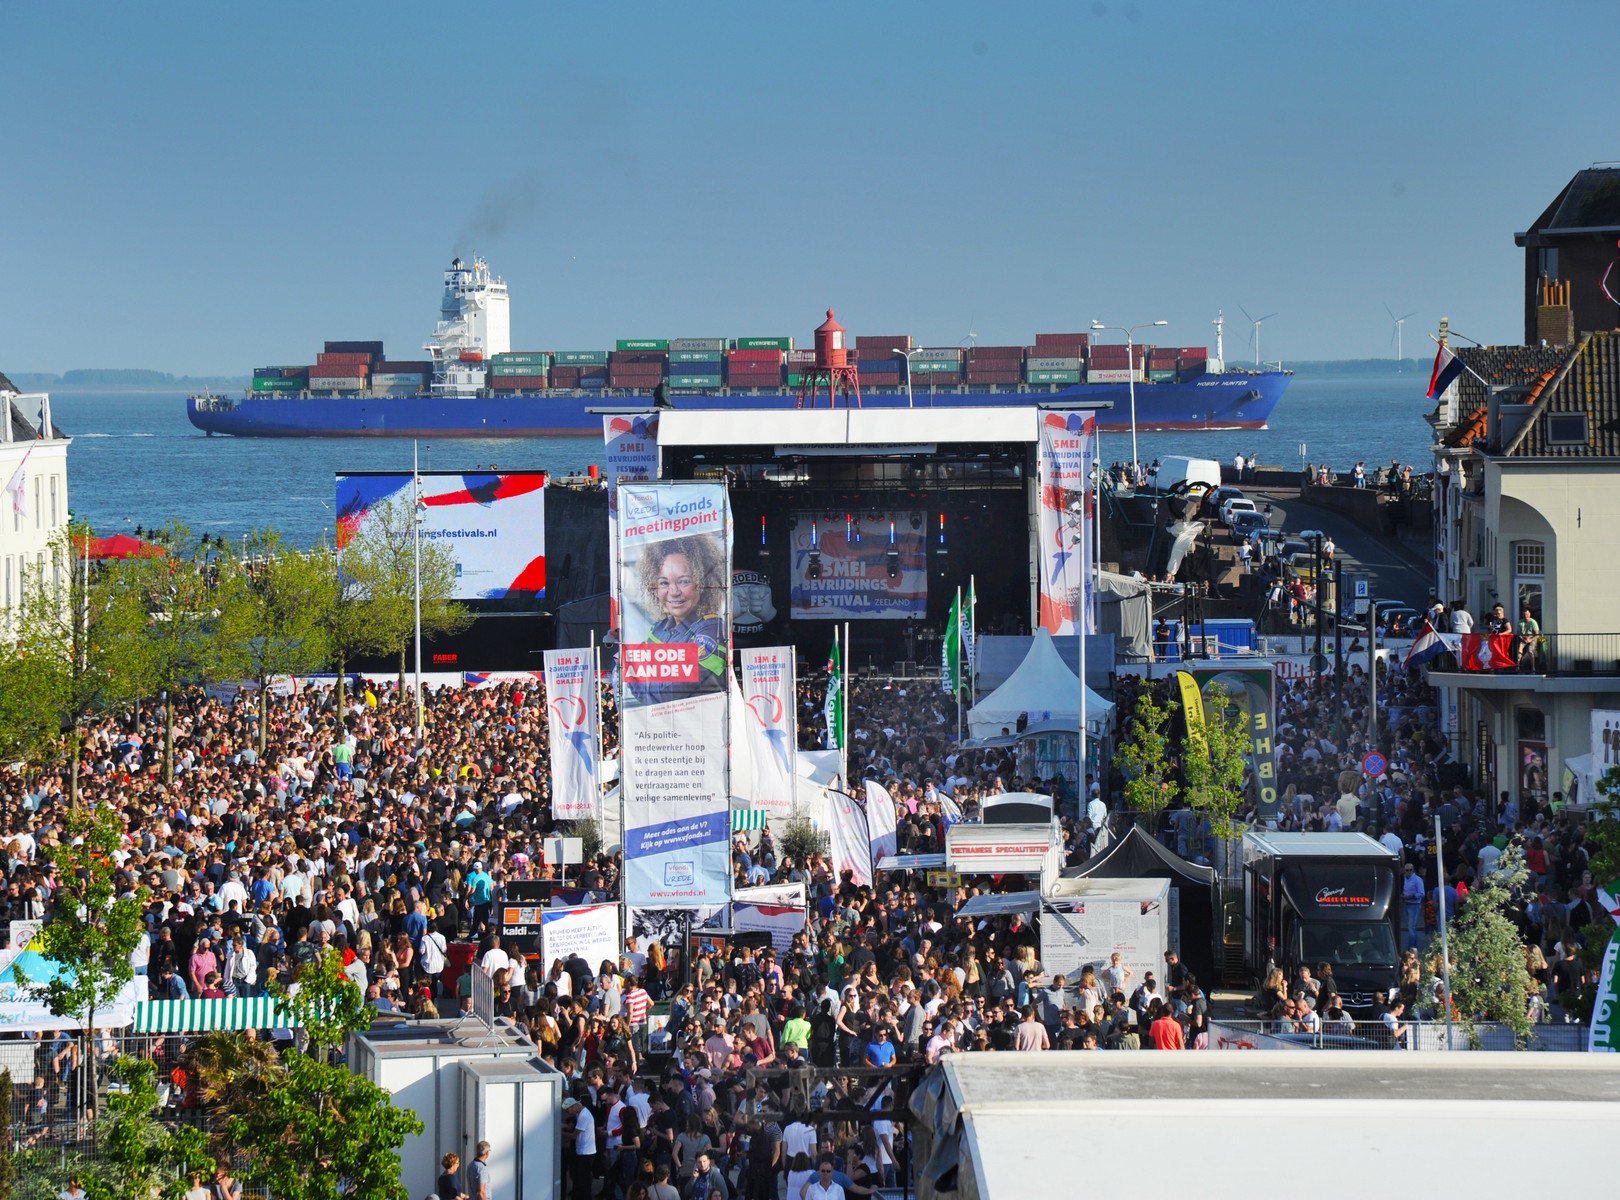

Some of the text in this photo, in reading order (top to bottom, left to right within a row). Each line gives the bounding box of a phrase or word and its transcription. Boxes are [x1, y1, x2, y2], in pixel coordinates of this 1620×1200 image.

[1053, 439, 1079, 449] 5MEI
[1050, 461, 1080, 469] FESTIVA
[628, 505, 657, 516] VREDE
[666, 496, 713, 516] vfonds
[625, 509, 718, 538] meetingpoint
[802, 579, 888, 591] BEVRIJDINGS
[810, 595, 871, 606] FESTIVAL
[874, 598, 911, 606] ZEELAND
[625, 649, 686, 662] EEN ODE
[625, 664, 694, 678] AAN DE V
[653, 731, 681, 741] politie-
[634, 744, 706, 753] medewerker hoop
[634, 756, 642, 764] ik
[660, 756, 693, 765] steentje
[695, 755, 706, 765] bij
[635, 769, 643, 777] te
[645, 769, 673, 778] dragen
[635, 781, 690, 790] verdraagzame
[635, 793, 661, 803] veilige
[643, 821, 708, 840] Meer odes aan de V?
[640, 829, 712, 850] Kijk op www.vfonds.nl
[950, 846, 993, 854] VIETNAMESE
[666, 875, 692, 883] VREDE
[649, 889, 706, 897] www.vfonds.nl
[502, 926, 528, 935] kaldi
